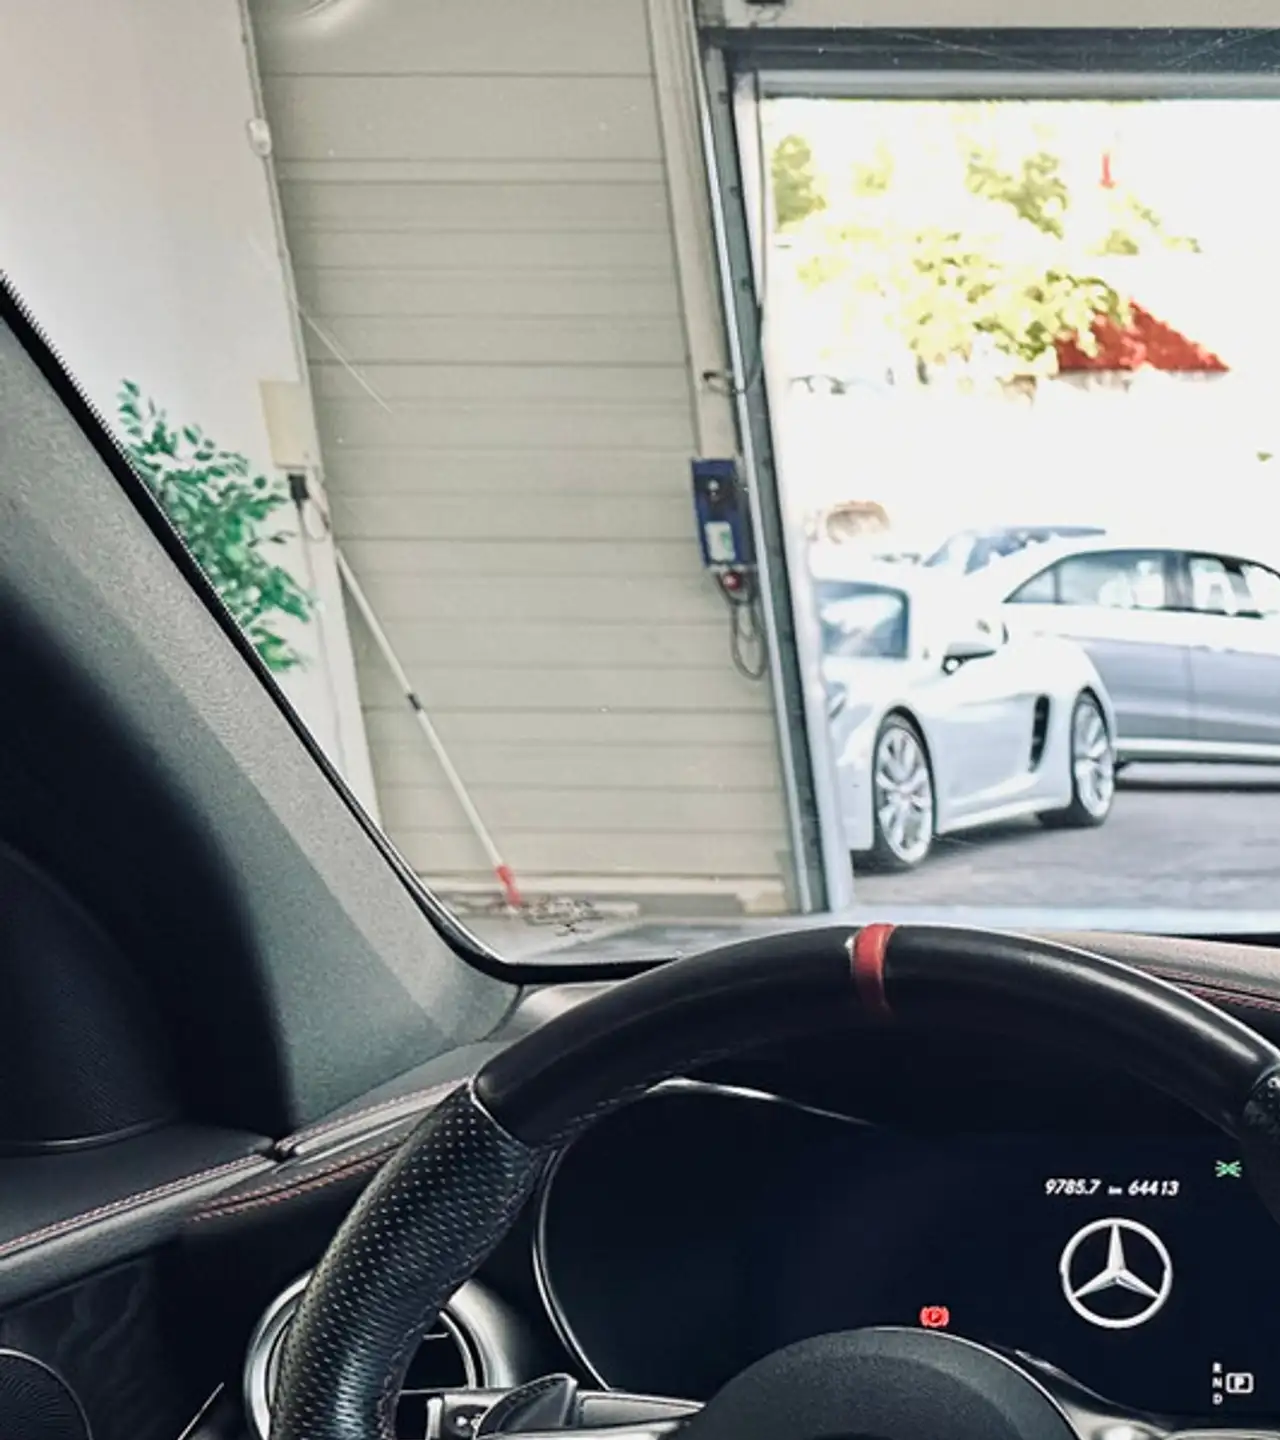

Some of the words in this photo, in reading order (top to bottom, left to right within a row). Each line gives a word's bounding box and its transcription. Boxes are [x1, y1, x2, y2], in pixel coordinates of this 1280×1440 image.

[1045, 1177, 1101, 1196] 9785.7
[1128, 1179, 1180, 1197] 64413
[1212, 1376, 1223, 1389] N
[1212, 1391, 1224, 1406] D
